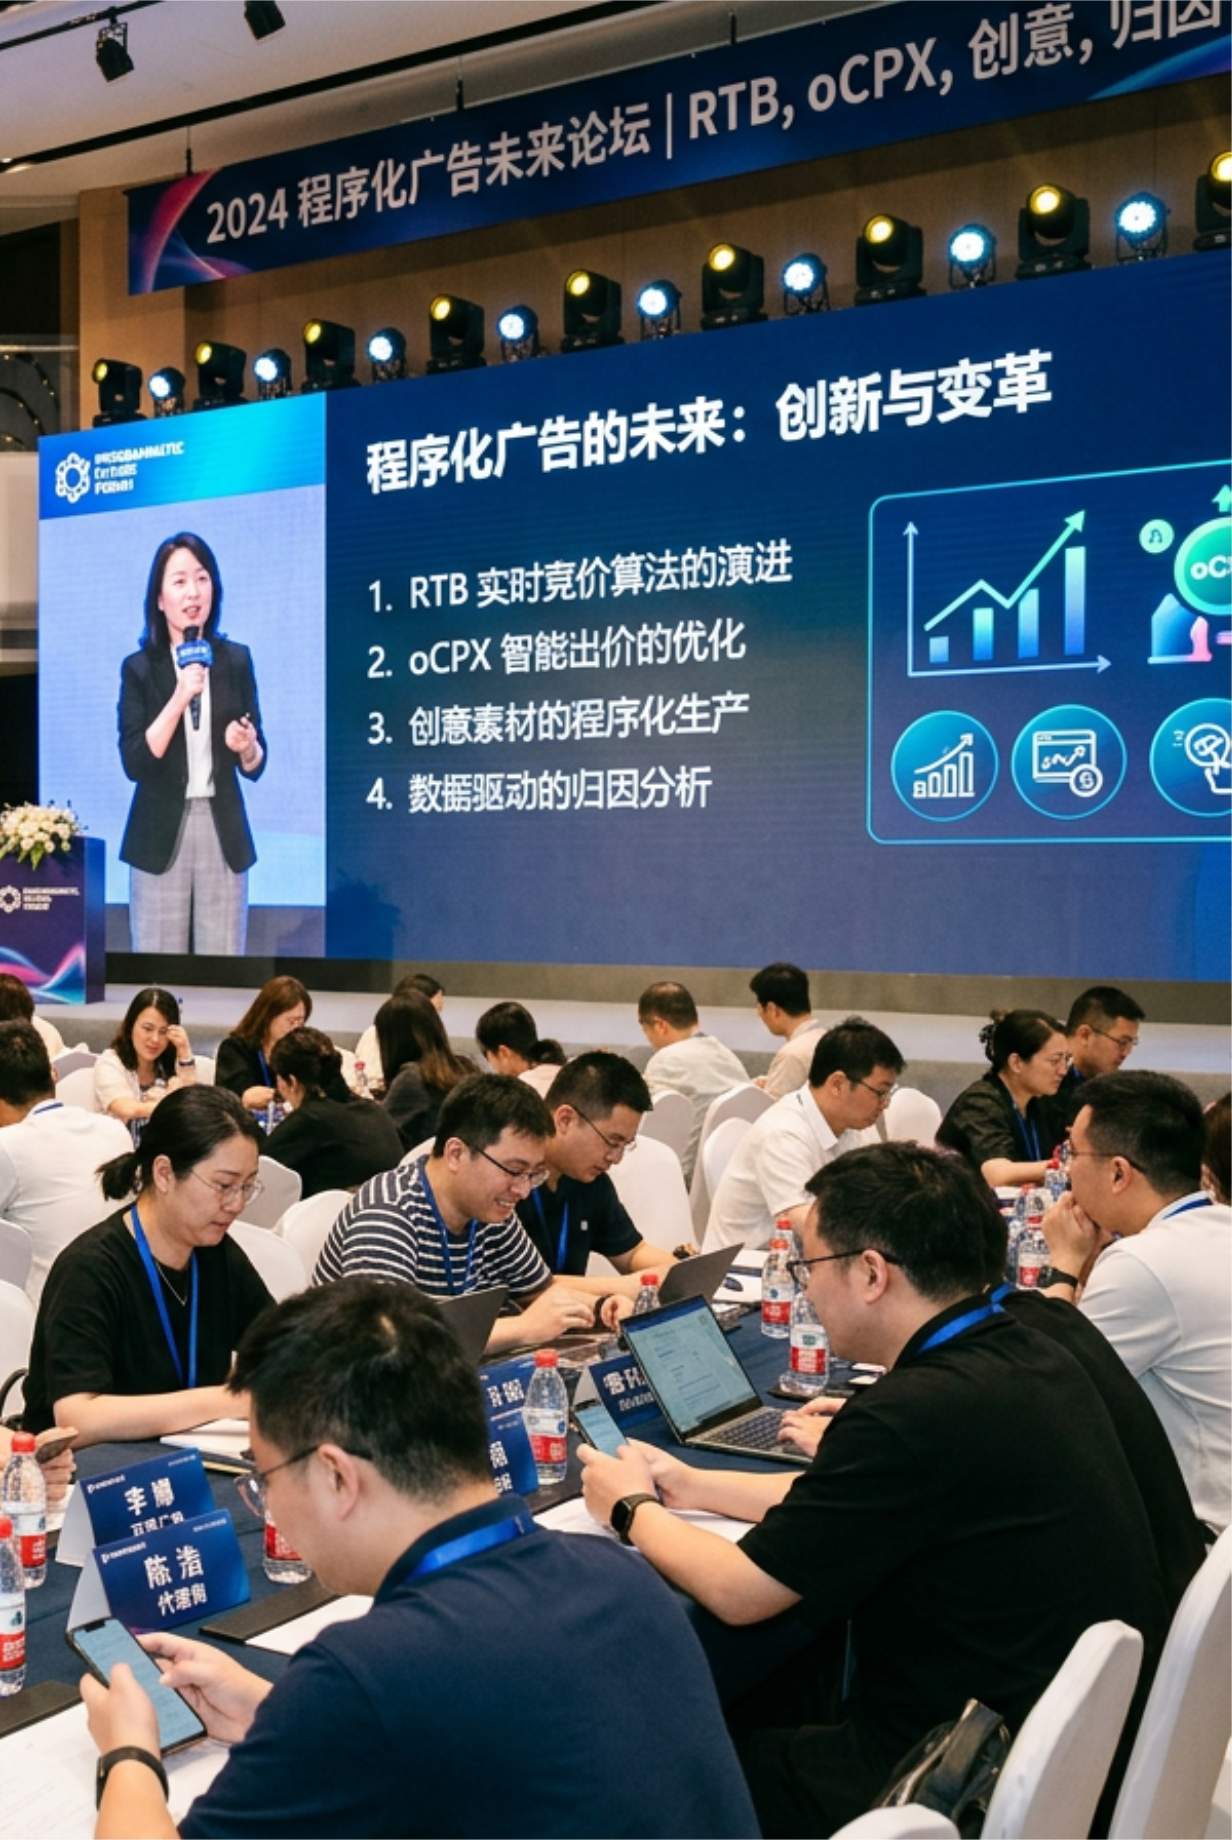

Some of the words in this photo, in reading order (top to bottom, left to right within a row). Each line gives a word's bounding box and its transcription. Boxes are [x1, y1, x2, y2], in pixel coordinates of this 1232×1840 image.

[207, 188, 288, 243] 2024
[298, 103, 650, 227] 程序化广告未来论坛
[690, 77, 794, 139] RTB,
[808, 38, 953, 111] oCPX,
[1111, 0, 1220, 49] 归因
[1190, 555, 1232, 580] oC
[369, 581, 392, 612] 1.
[411, 573, 468, 608] RTB
[368, 646, 392, 678] 2.
[410, 638, 491, 675] oCPX
[501, 618, 746, 674] 智能出价的优化
[368, 712, 392, 744] 3.
[367, 778, 392, 809] 4.
